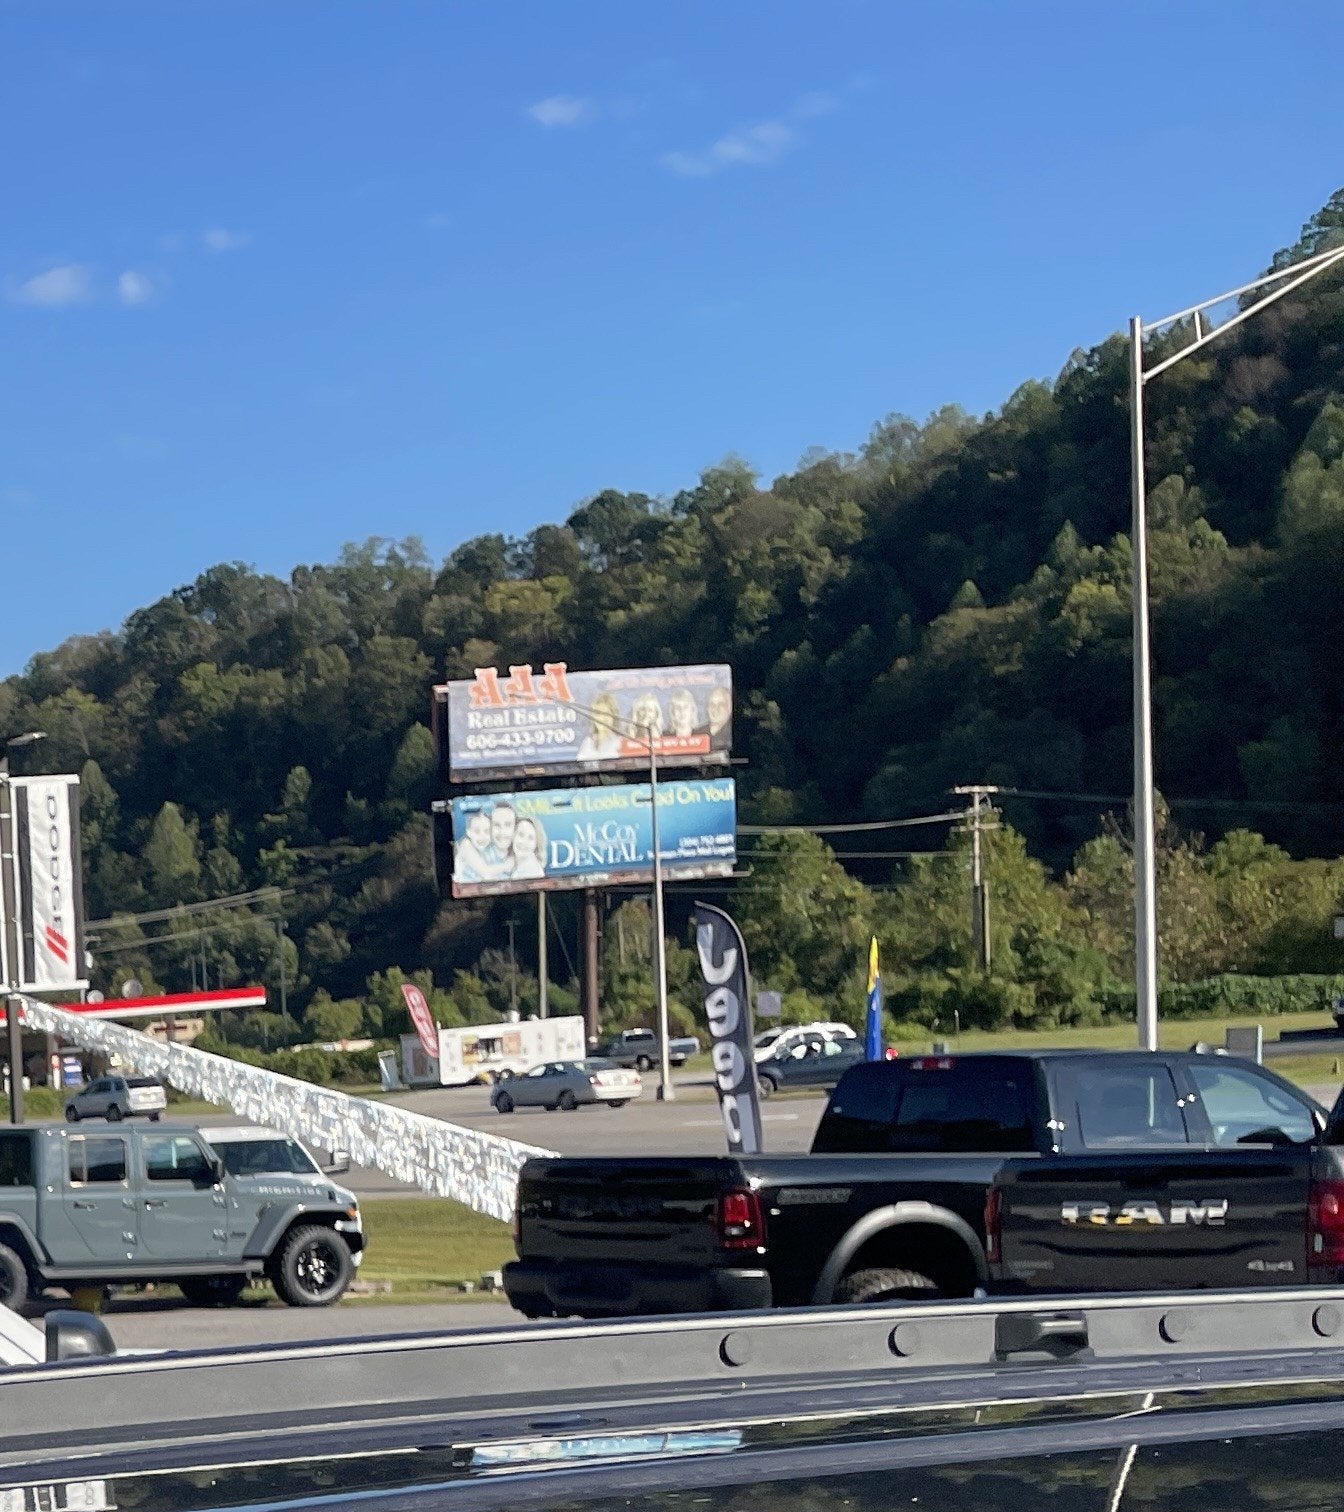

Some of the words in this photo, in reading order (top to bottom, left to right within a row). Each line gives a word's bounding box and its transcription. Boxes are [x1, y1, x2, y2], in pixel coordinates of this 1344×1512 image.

[467, 709, 510, 729] Real
[512, 706, 577, 726] Estate
[677, 786, 701, 805] On
[550, 840, 644, 868] DENTAL
[1060, 1199, 1229, 1226] RAM
